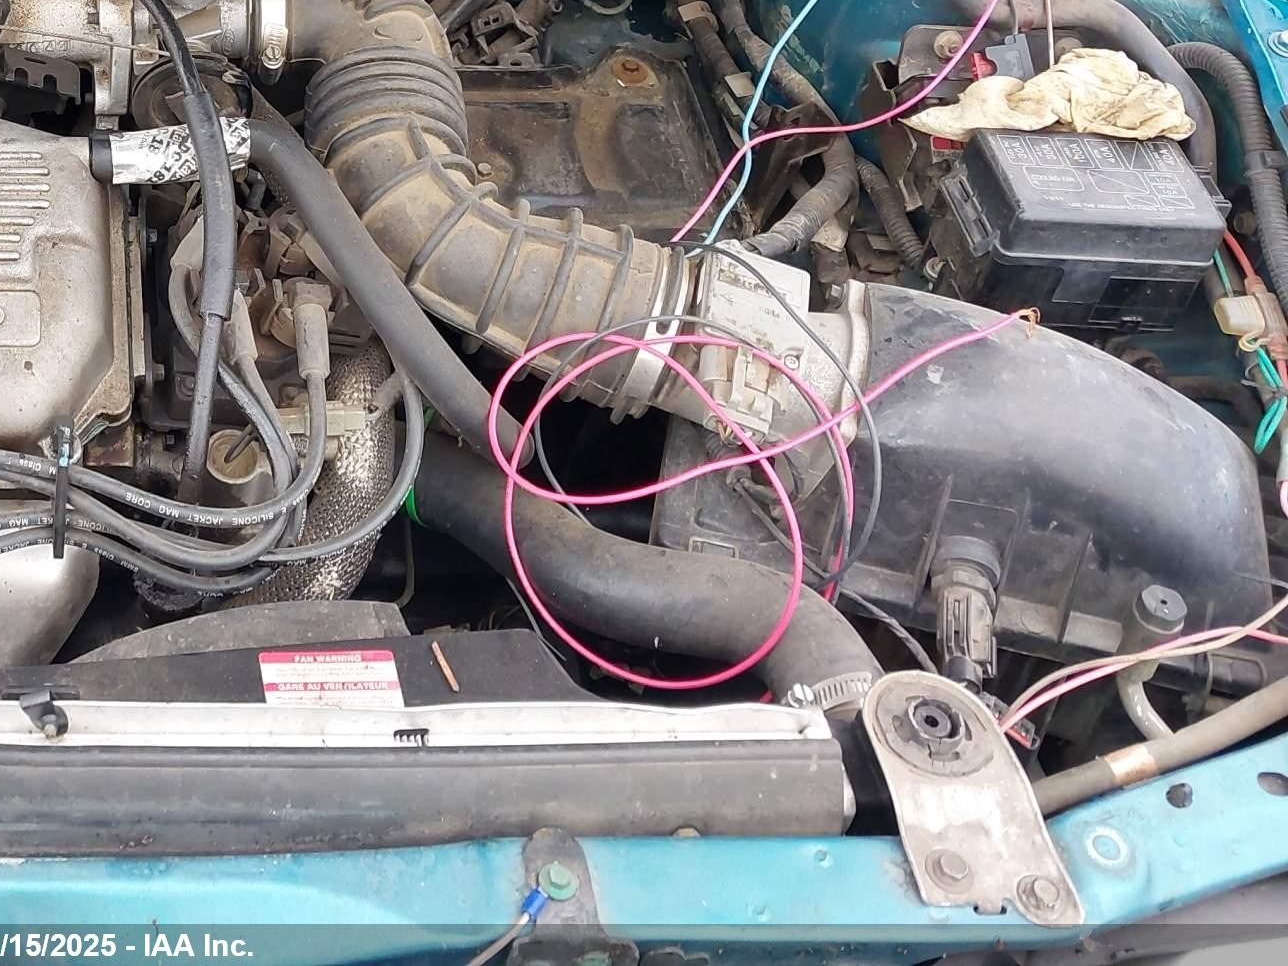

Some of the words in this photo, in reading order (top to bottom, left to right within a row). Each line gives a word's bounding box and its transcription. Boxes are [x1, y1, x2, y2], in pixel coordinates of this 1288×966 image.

[18, 458, 42, 471] Class
[125, 492, 152, 508] CORE
[158, 504, 179, 518] MAG
[10, 517, 29, 526] MAG
[186, 514, 224, 525] JACKET
[231, 512, 274, 526] SILICONE
[294, 655, 315, 663] FAN
[315, 654, 362, 663] WARNING
[278, 683, 305, 691] GARE
